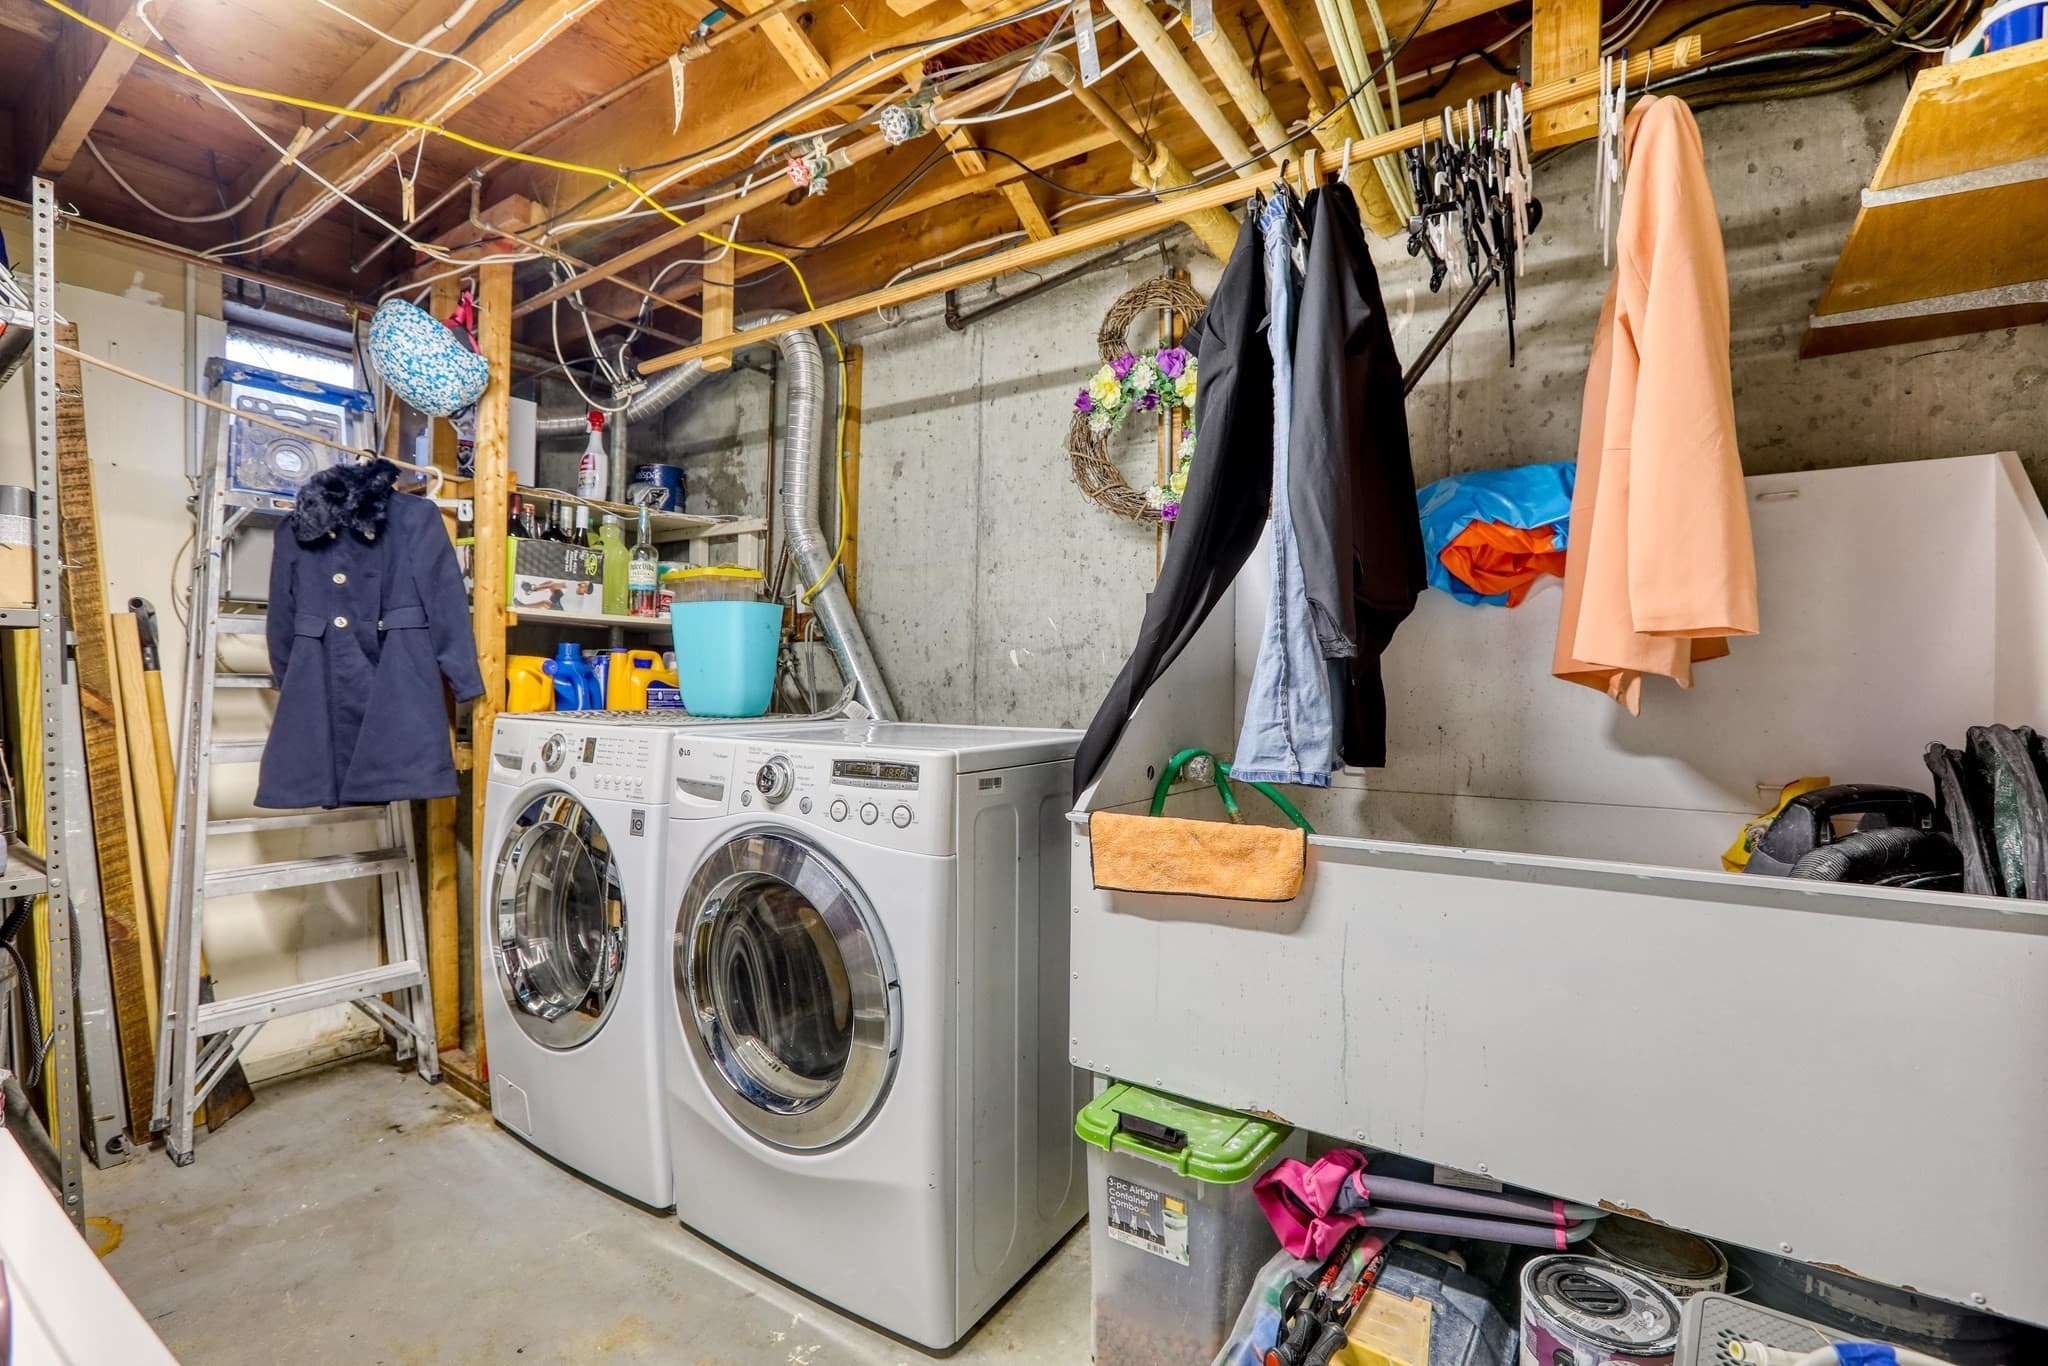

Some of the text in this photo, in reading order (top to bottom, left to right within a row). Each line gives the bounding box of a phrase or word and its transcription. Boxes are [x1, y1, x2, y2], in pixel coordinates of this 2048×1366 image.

[1108, 1177, 1159, 1201] 3-pc Airtight
[1108, 1188, 1149, 1207] Container
[1109, 1196, 1140, 1213] Combo
